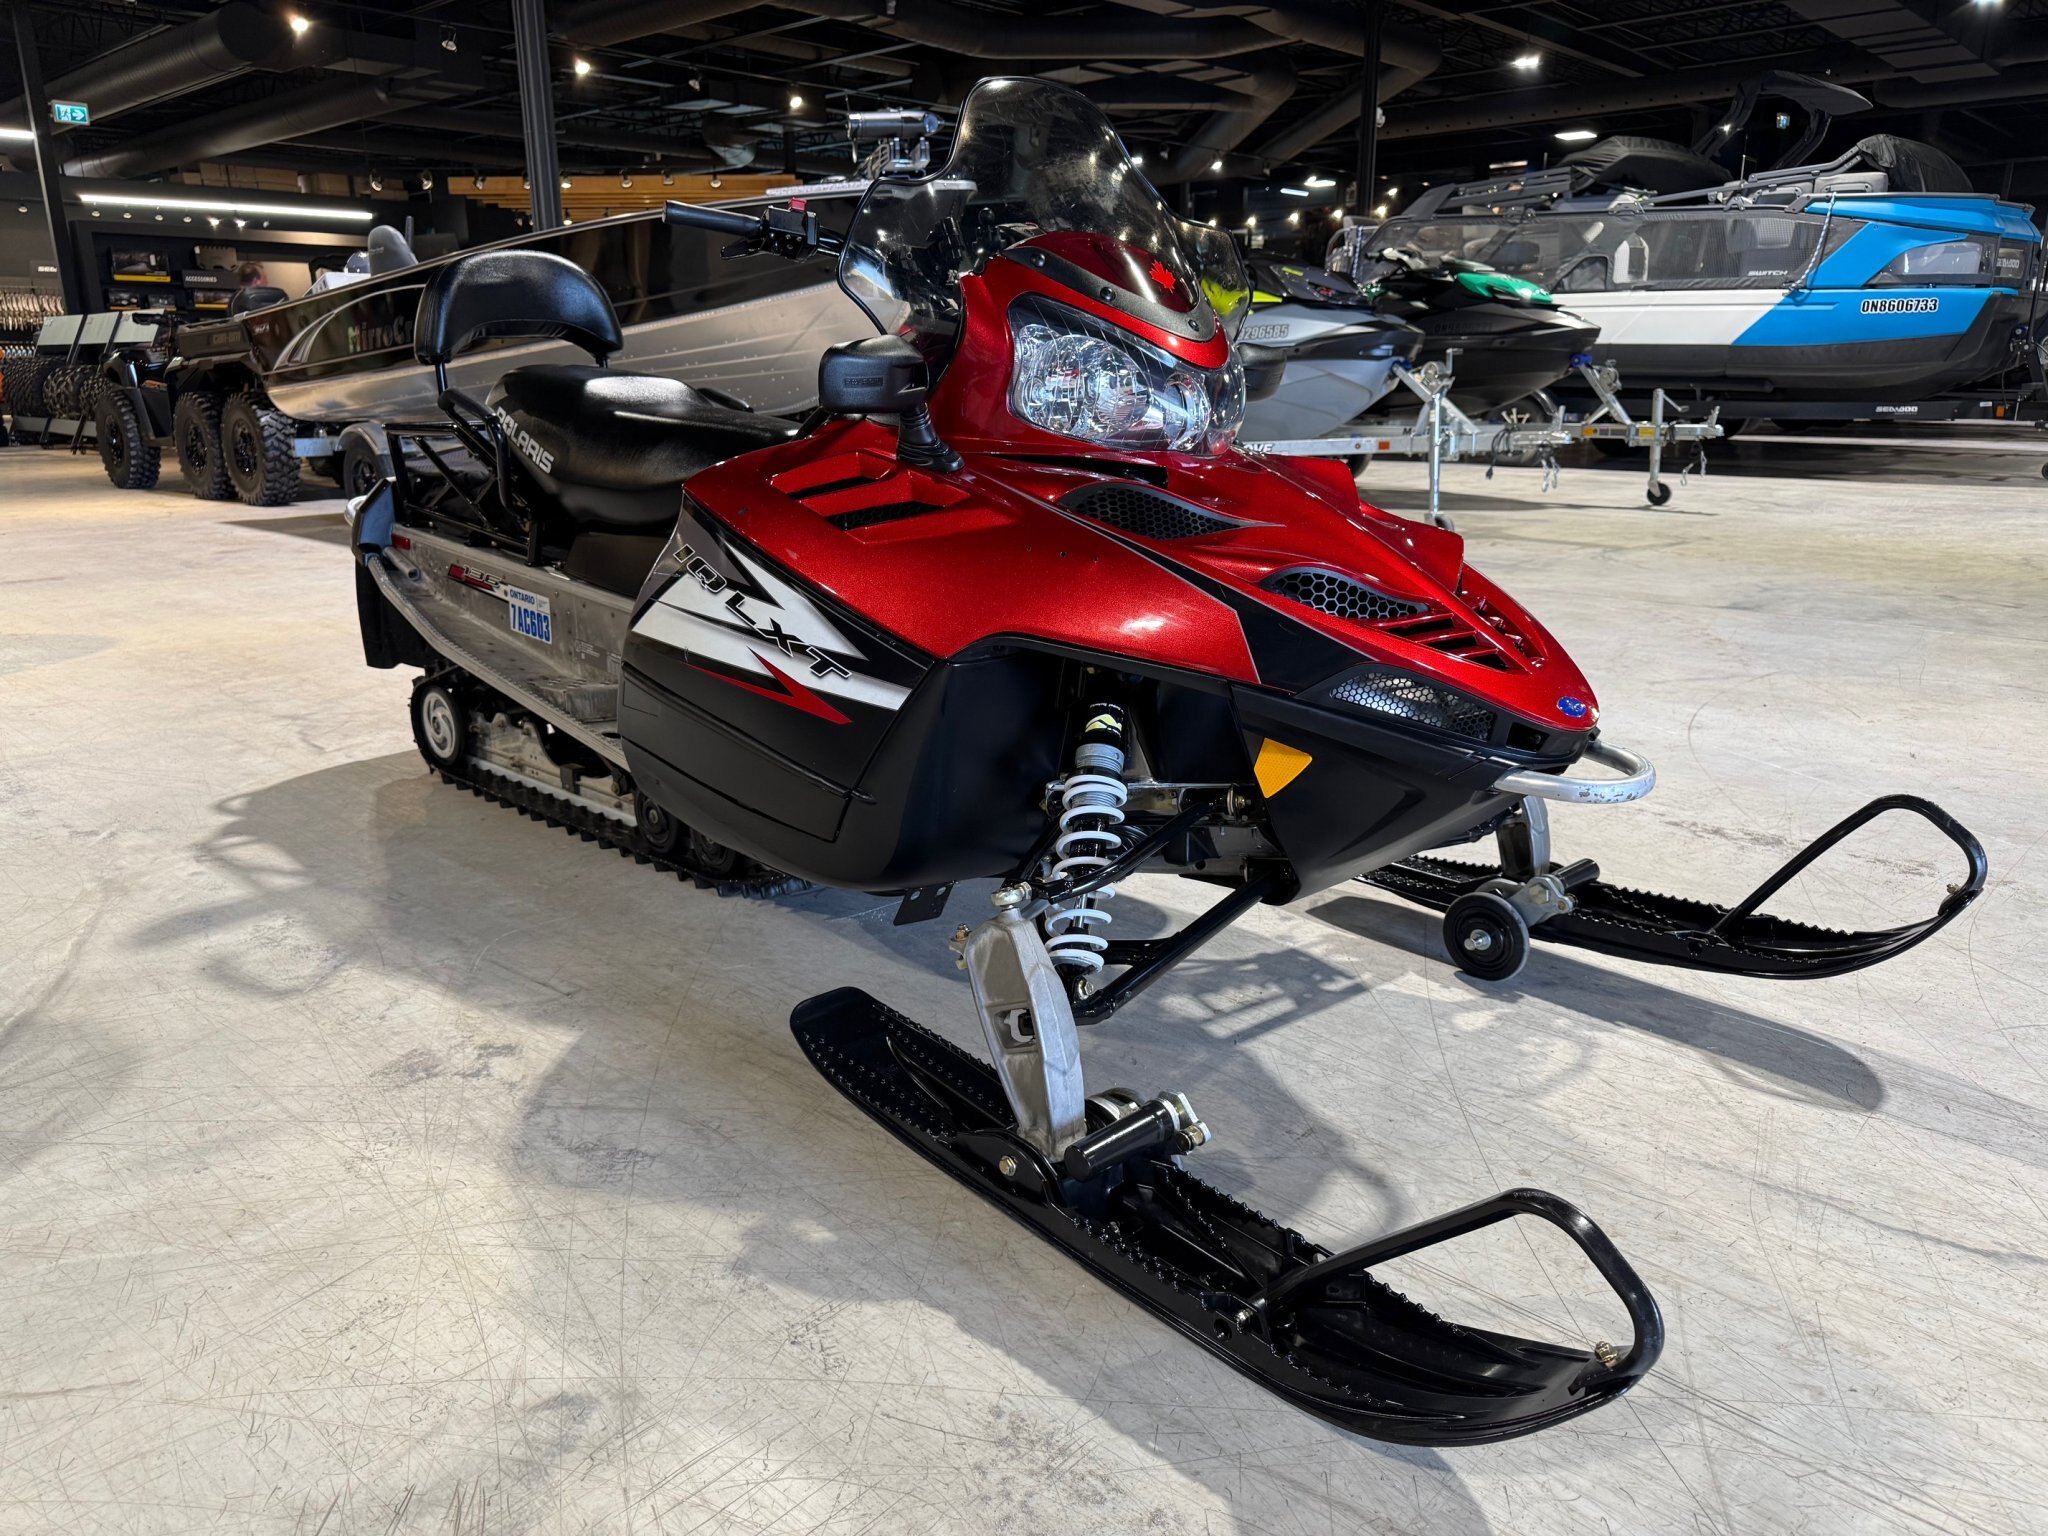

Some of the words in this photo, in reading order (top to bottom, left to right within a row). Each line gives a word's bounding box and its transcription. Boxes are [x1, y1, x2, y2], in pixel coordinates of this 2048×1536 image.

[1860, 298, 1939, 314] ON8606733
[496, 405, 555, 474] POLARIS
[463, 564, 502, 589] 136
[509, 589, 535, 605] ONTARIO
[511, 603, 551, 642] 7AC603
[724, 590, 853, 679] LXT
